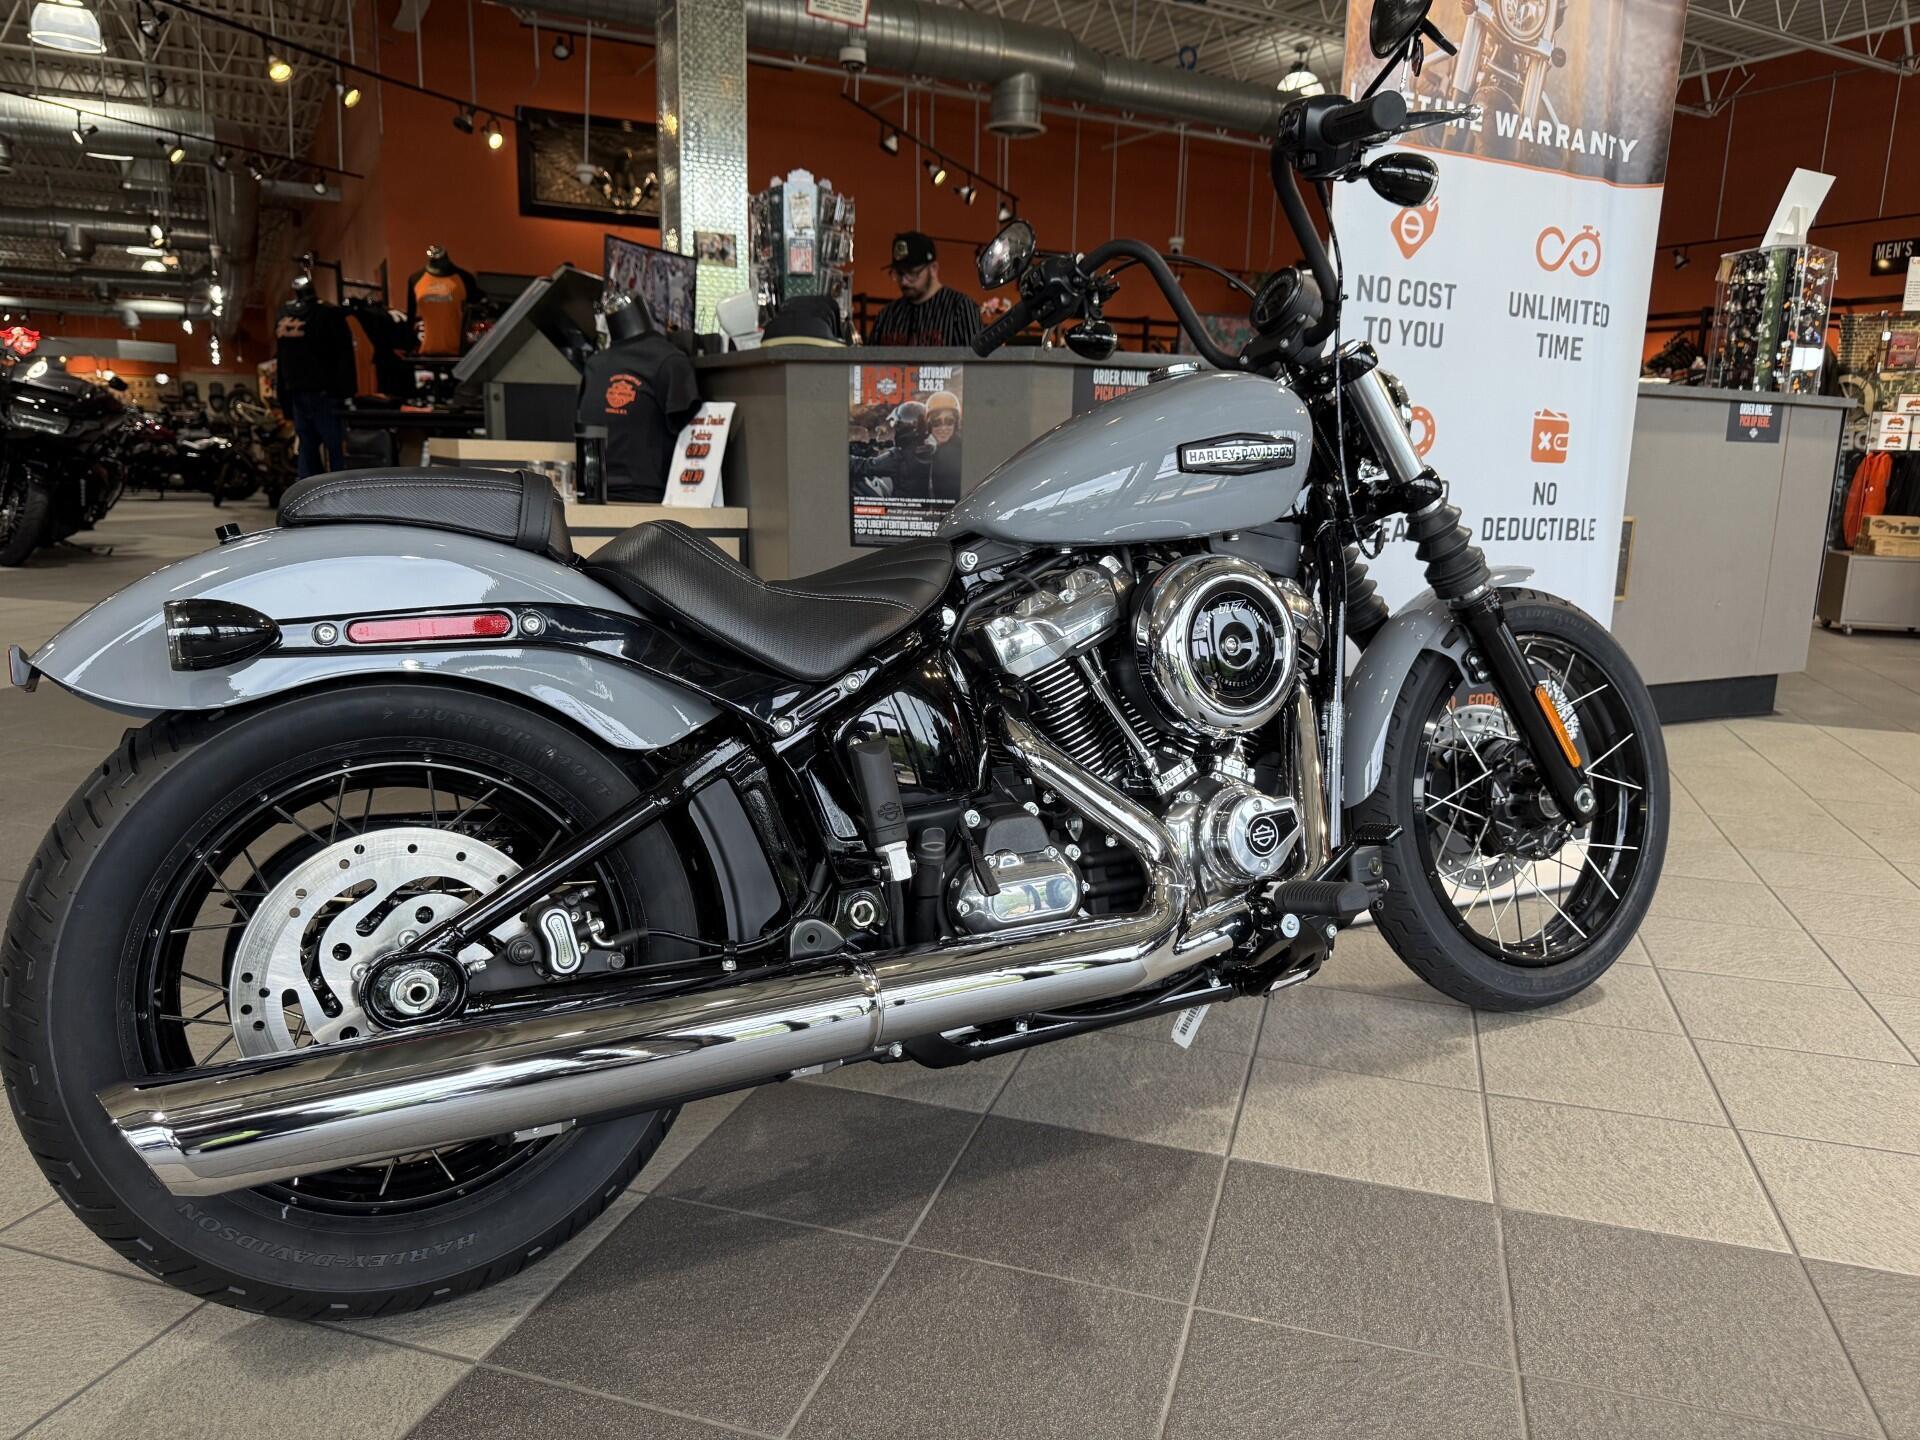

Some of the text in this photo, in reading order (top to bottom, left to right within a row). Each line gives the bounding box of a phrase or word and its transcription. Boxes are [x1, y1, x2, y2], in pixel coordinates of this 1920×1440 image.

[1495, 110, 1639, 163] WARRANTY
[1875, 241, 1914, 260] MEN'S
[1356, 274, 1457, 310] NO COST
[1508, 291, 1610, 328] UNLIMITED
[1363, 316, 1444, 349] TO YOU
[1536, 332, 1584, 362] TIME
[919, 366, 952, 379] SATURDAY
[1093, 368, 1120, 385] ORDER
[863, 366, 919, 405] RIDE
[919, 380, 944, 392] 6.20.26
[1094, 385, 1114, 401] PICK
[1189, 446, 1293, 463] HARLEY-DAVIDSON
[1532, 482, 1557, 506] NO
[868, 520, 888, 529] LIBERTY
[909, 521, 933, 531] HERITAGE
[1481, 517, 1596, 541] DEDUCTIBLE
[1219, 599, 1247, 615] 117
[174, 1201, 479, 1270] HARLEY-DAVIDSON
